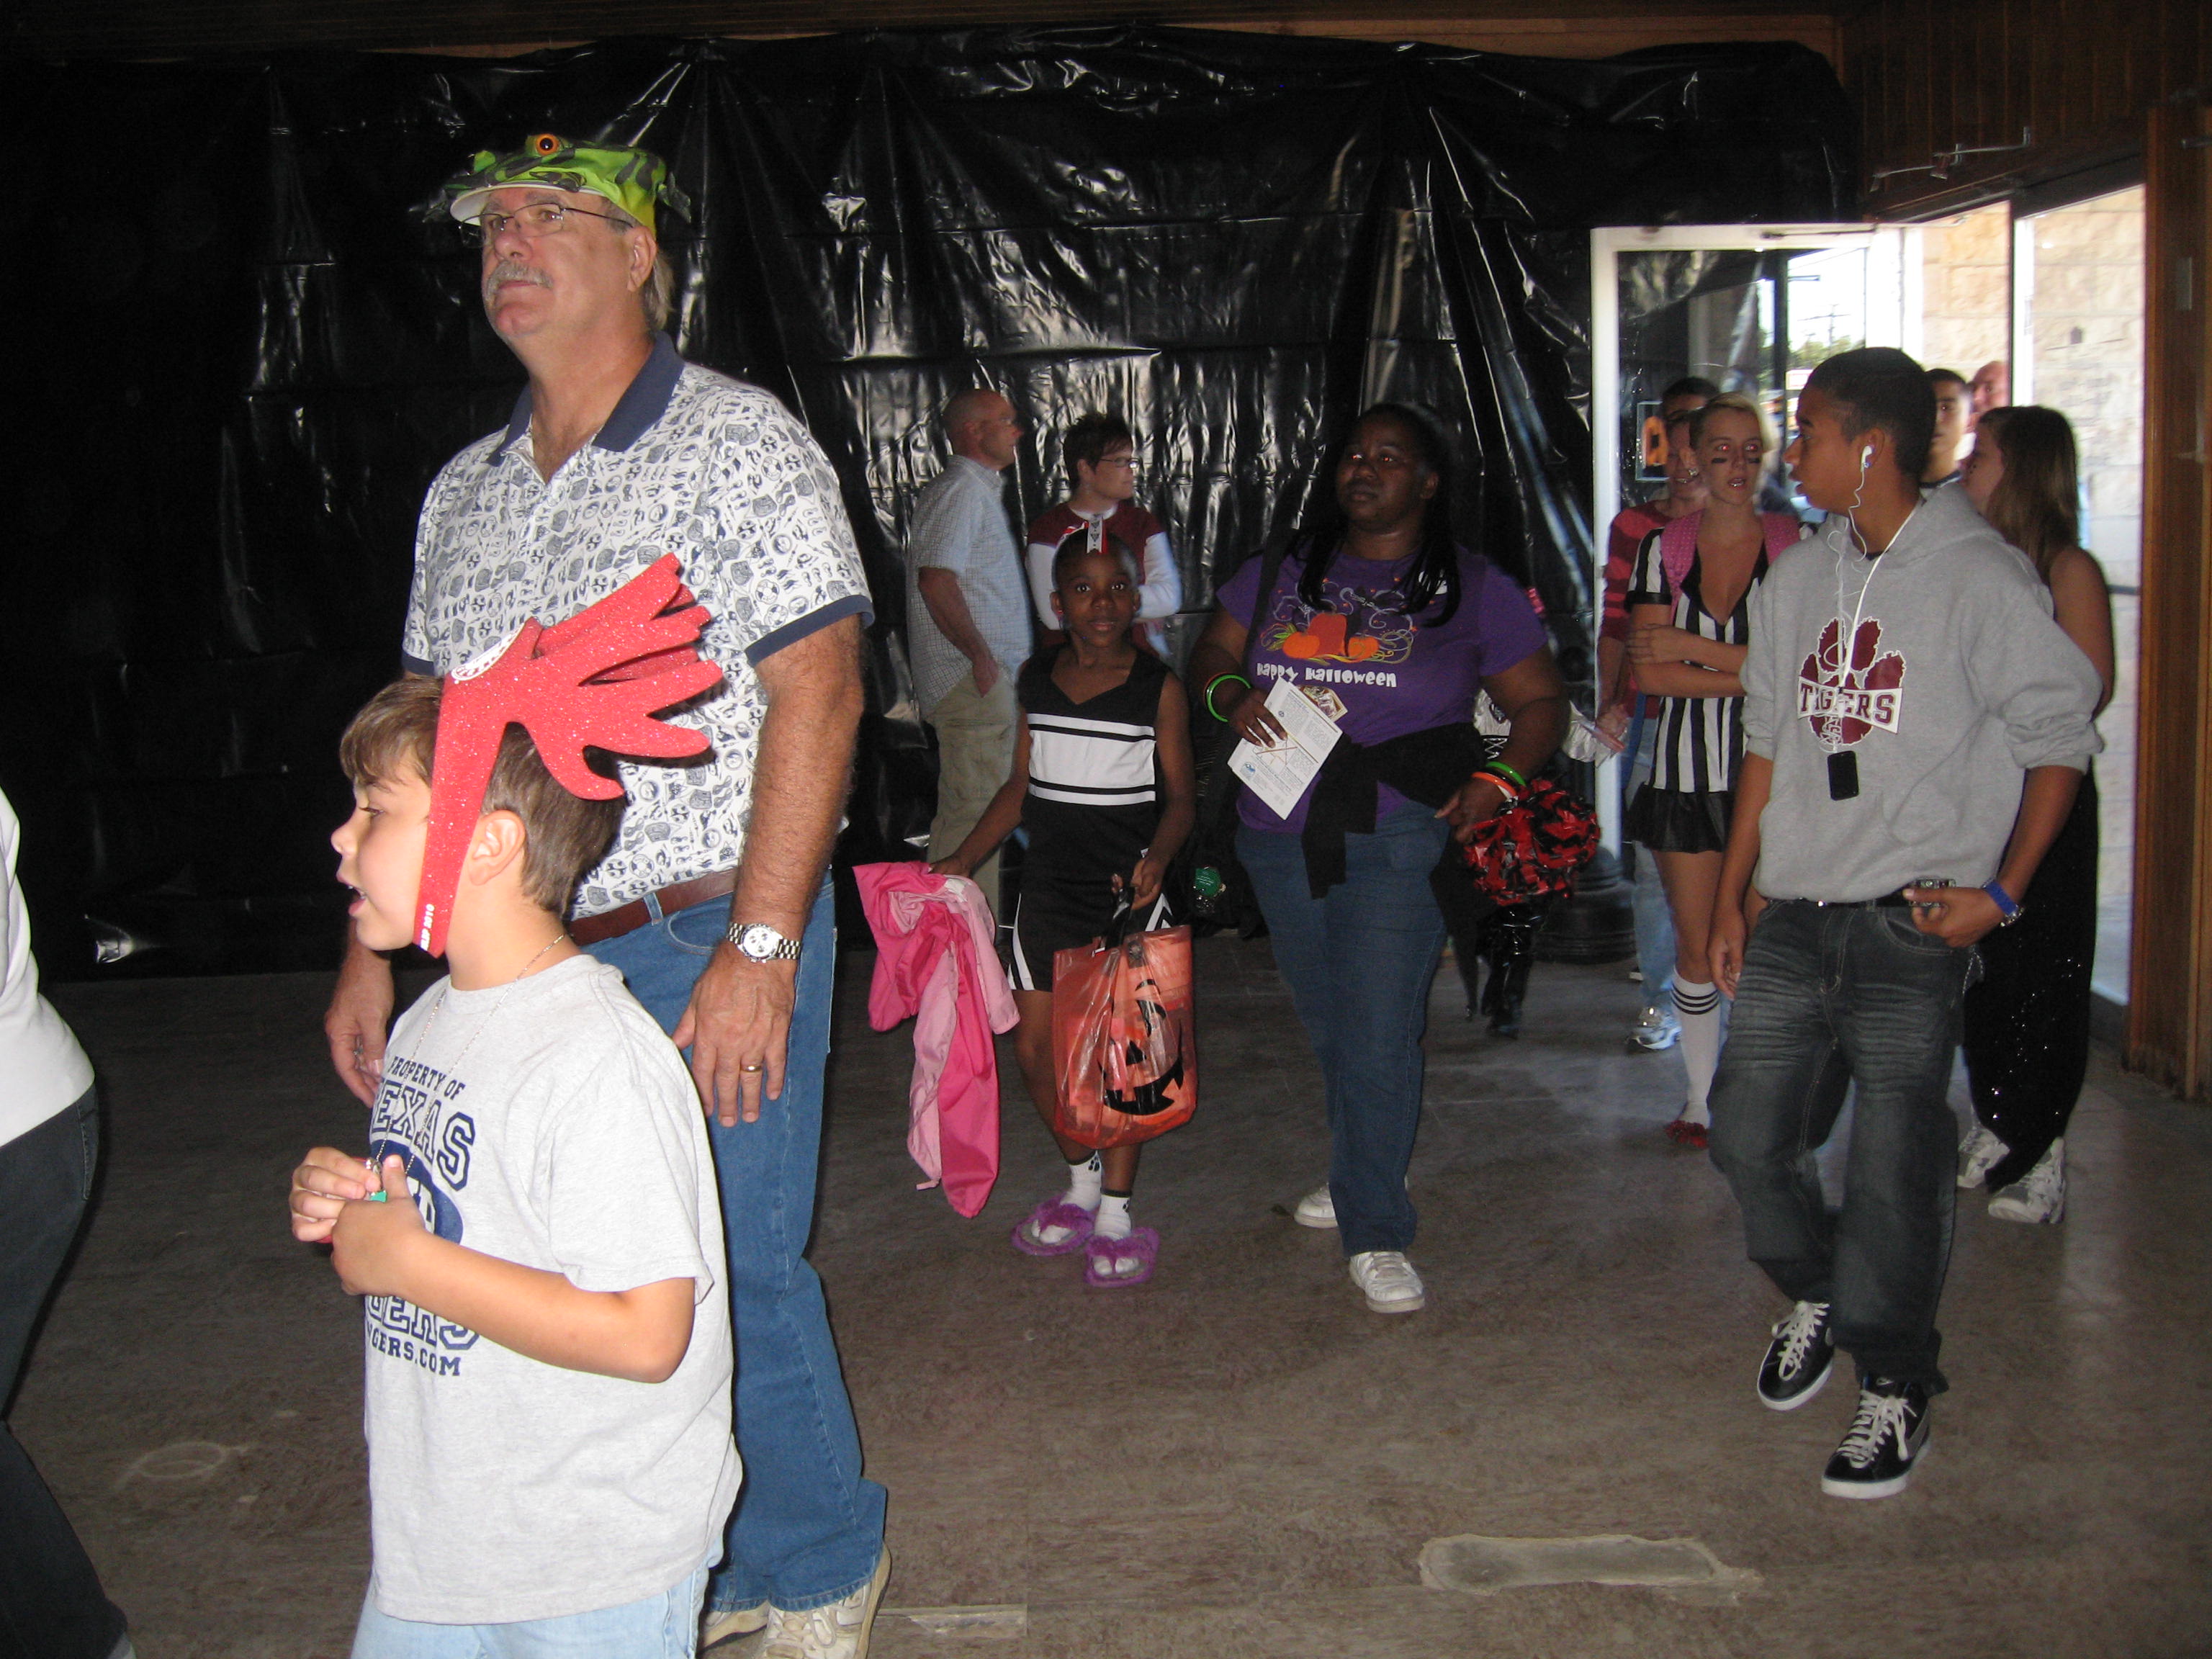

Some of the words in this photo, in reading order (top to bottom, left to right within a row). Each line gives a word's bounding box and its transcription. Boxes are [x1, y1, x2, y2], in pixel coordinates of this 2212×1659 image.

[423, 903, 435, 929] 2010
[387, 1056, 446, 1091] PROPERTY
[444, 1079, 467, 1101] OF
[371, 1077, 476, 1192] EXAS
